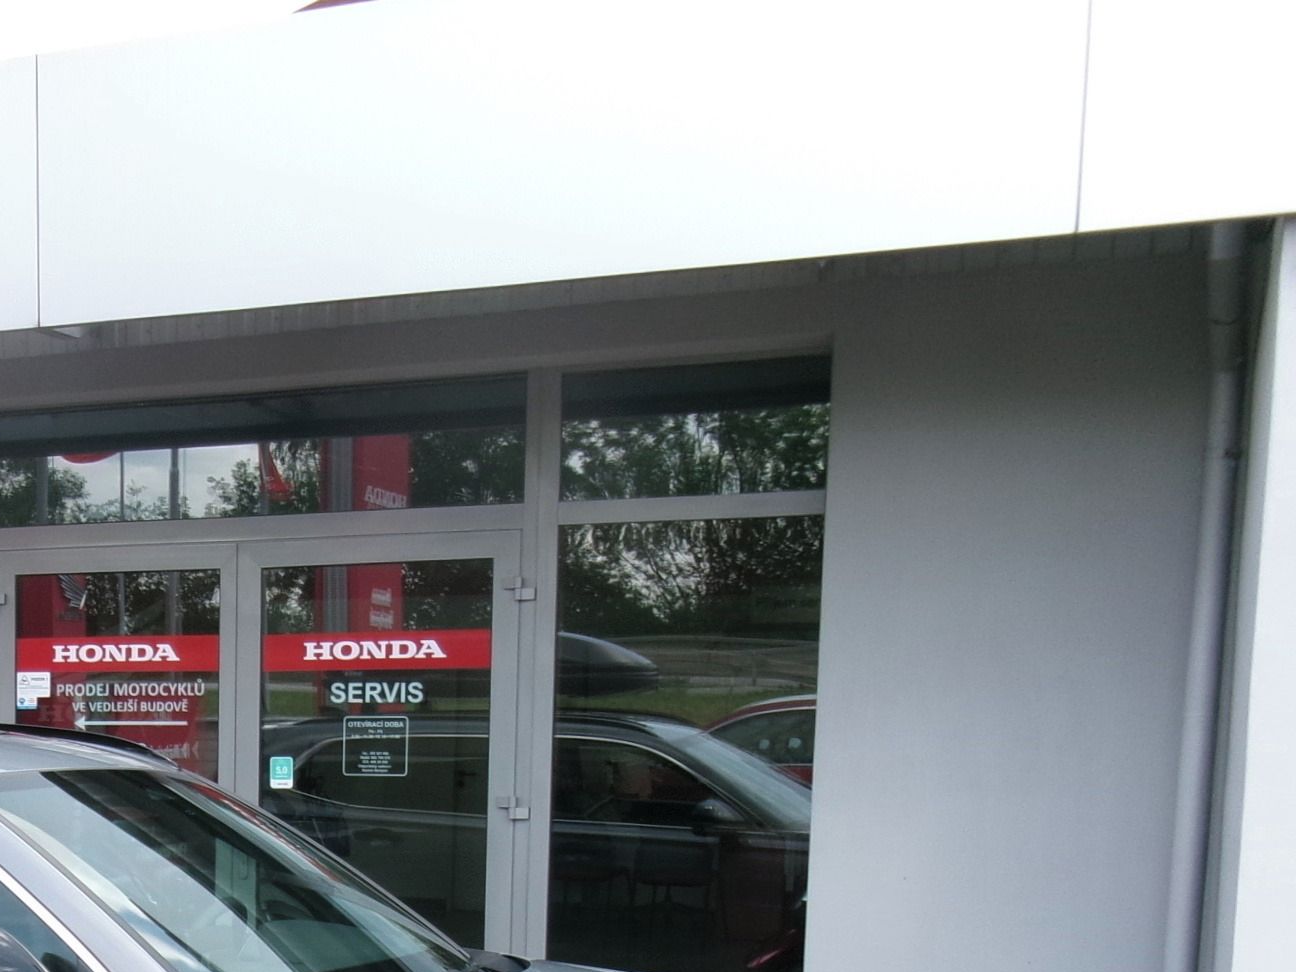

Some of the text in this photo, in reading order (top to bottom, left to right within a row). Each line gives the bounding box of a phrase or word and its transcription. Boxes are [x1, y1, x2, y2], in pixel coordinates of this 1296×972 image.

[52, 643, 181, 663] HONDA
[303, 639, 448, 661] HONDA
[56, 678, 206, 698] PRODEJ MOTOCYKLŮ
[329, 681, 424, 704] SERVIS
[72, 698, 189, 713] VE VEDLEJŠÍ BUDOVĚ
